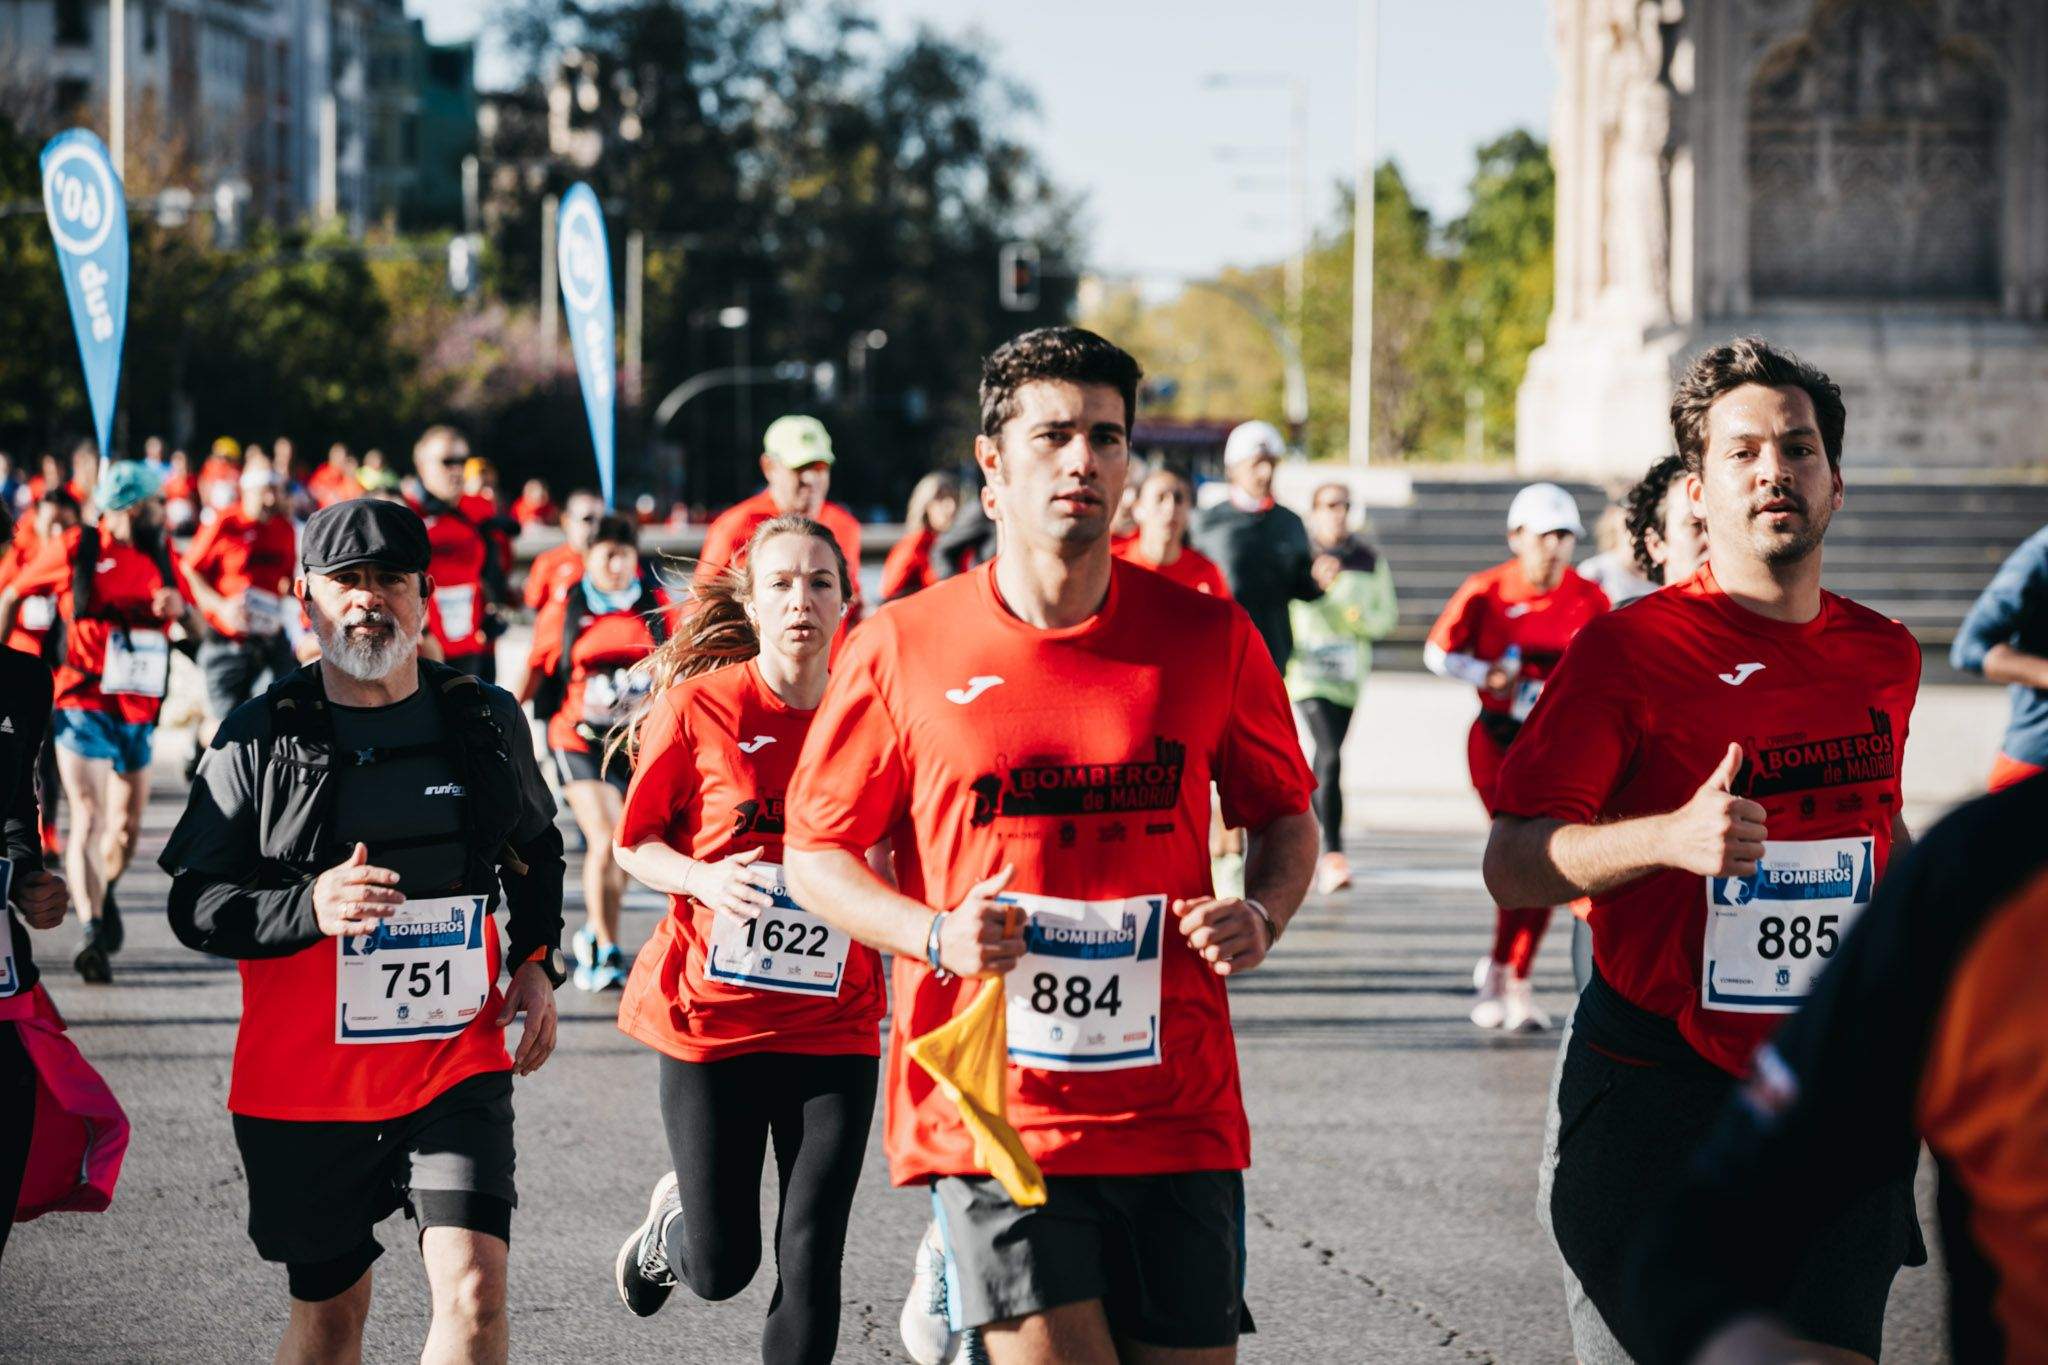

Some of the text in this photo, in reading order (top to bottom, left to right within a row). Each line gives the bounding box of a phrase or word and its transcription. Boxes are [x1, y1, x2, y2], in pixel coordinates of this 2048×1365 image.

[1768, 733, 1892, 770] BOMBEROS
[1020, 765, 1177, 790] BOMBEROS
[1823, 753, 1893, 784] de MADRID
[1082, 785, 1176, 810] de MADRID
[1769, 867, 1851, 885] BOMBEROS
[389, 920, 464, 937] BOMBEROS
[742, 917, 829, 958] 1622
[1044, 927, 1134, 945] BOMBEROS
[1757, 914, 1840, 960] 885
[381, 959, 450, 999] 751
[1031, 971, 1122, 1018] 884
